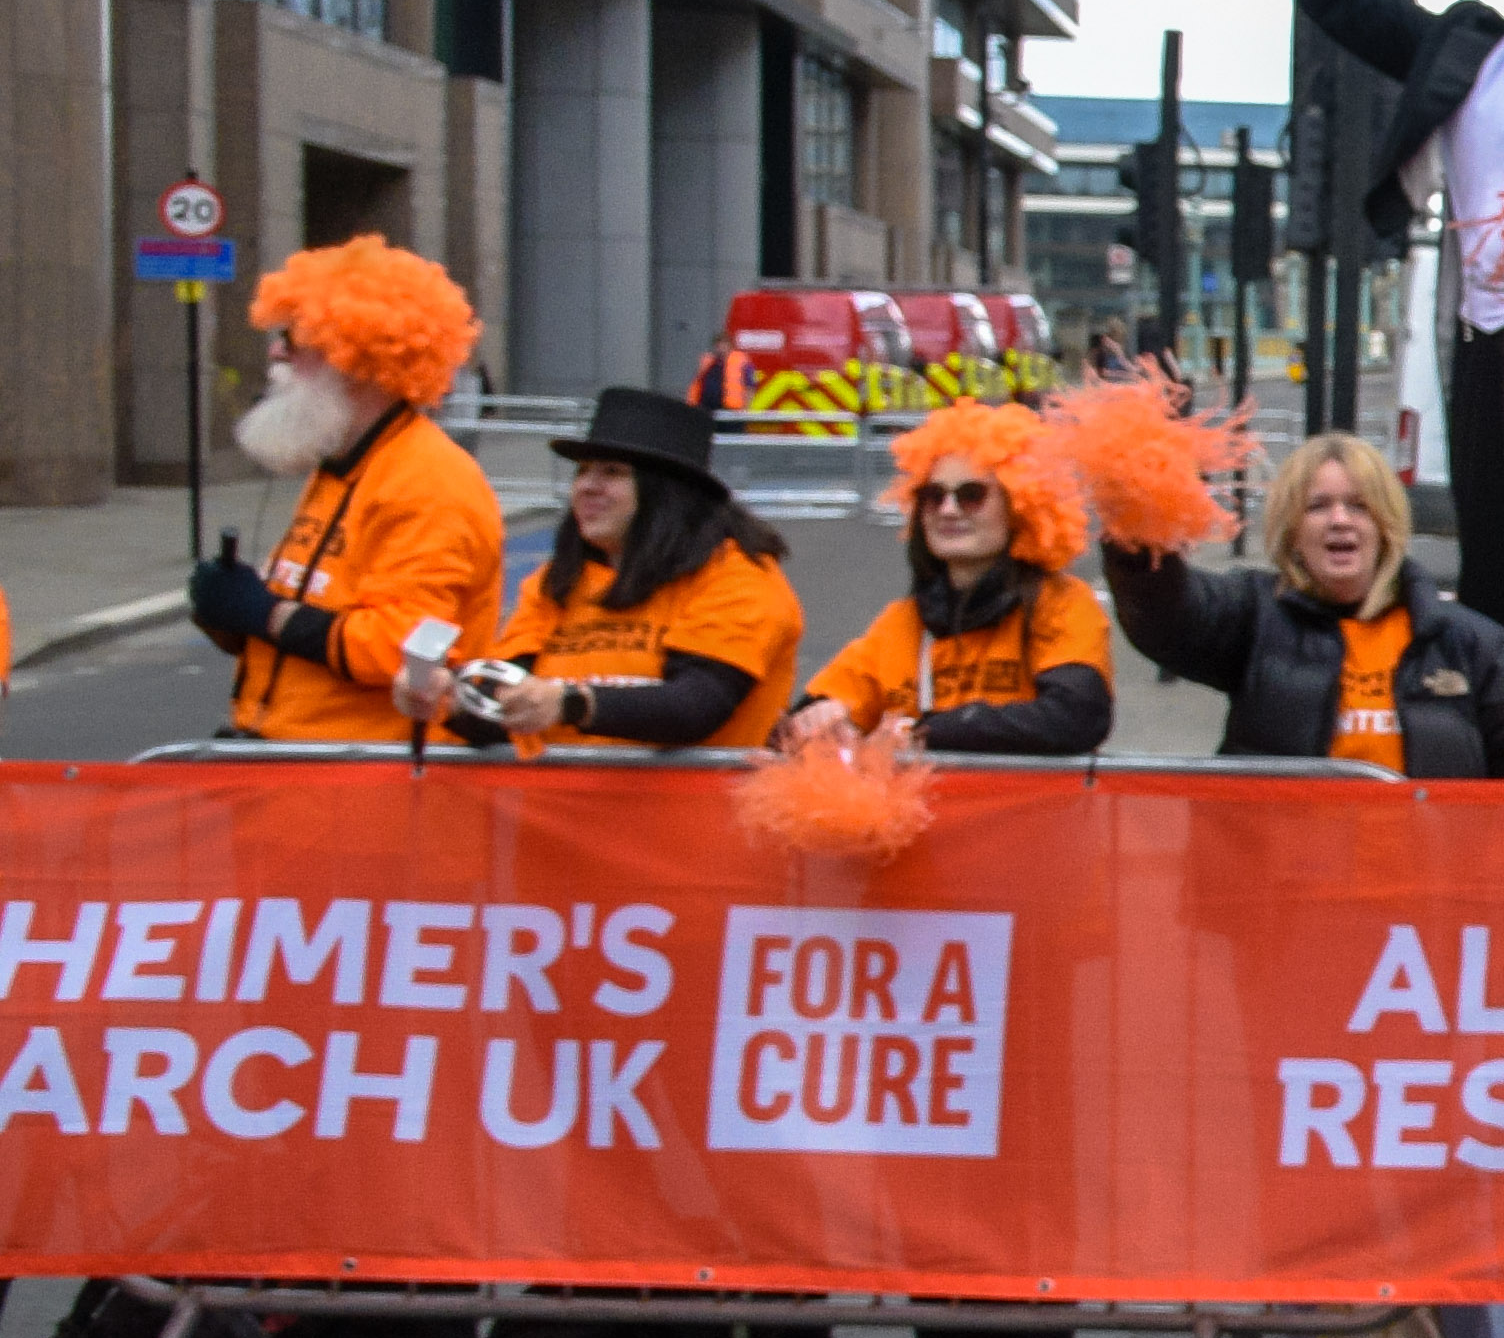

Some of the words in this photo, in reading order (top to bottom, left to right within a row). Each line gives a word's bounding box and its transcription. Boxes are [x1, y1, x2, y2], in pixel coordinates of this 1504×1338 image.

[170, 196, 215, 224] 20
[747, 935, 900, 1021] FOR
[923, 941, 977, 1024] A
[479, 1037, 666, 1151] UK
[738, 1030, 975, 1127] CURE
